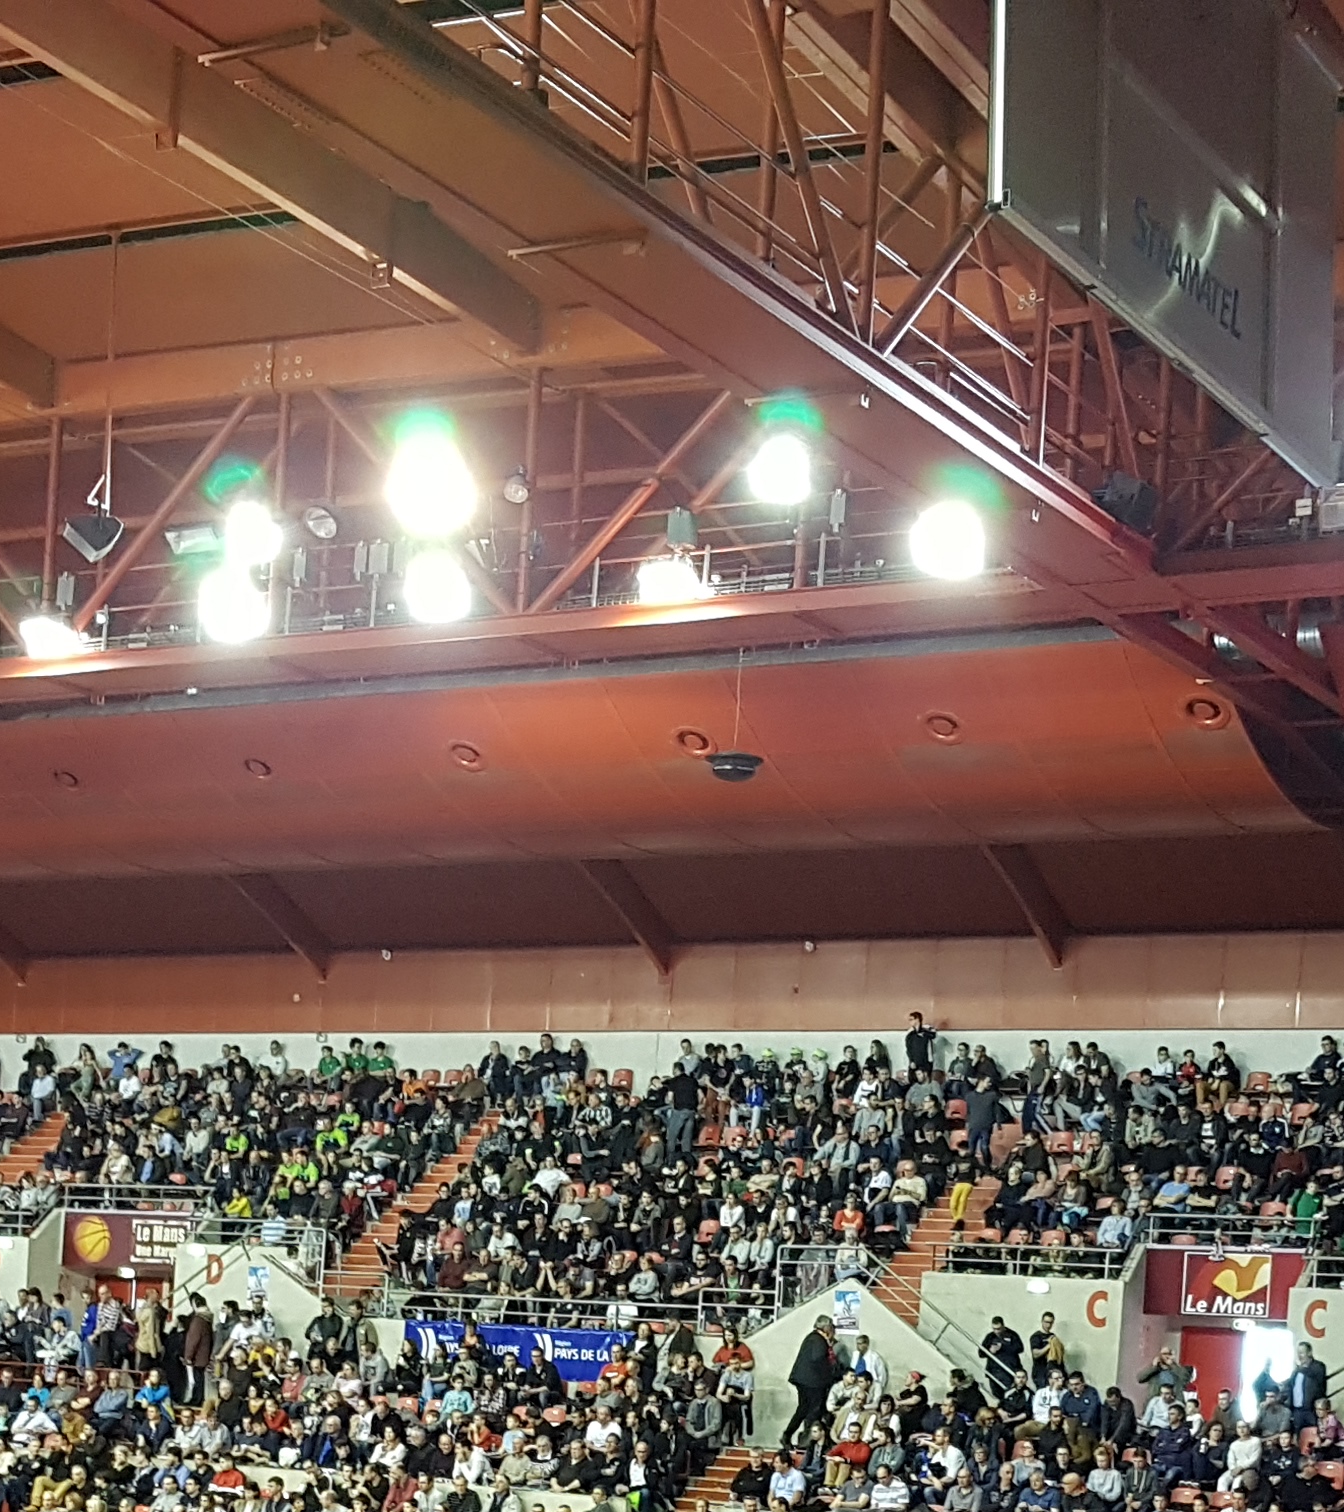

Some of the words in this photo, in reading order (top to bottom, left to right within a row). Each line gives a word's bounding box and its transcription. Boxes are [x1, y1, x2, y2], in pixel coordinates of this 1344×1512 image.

[206, 1253, 224, 1285] D
[1086, 1290, 1109, 1328] C
[1185, 1294, 1208, 1312] Le
[1212, 1296, 1265, 1316] Mans
[1304, 1299, 1328, 1339] C
[554, 1348, 579, 1360] PAYS
[581, 1349, 595, 1361] DE
[596, 1350, 610, 1362] LA
